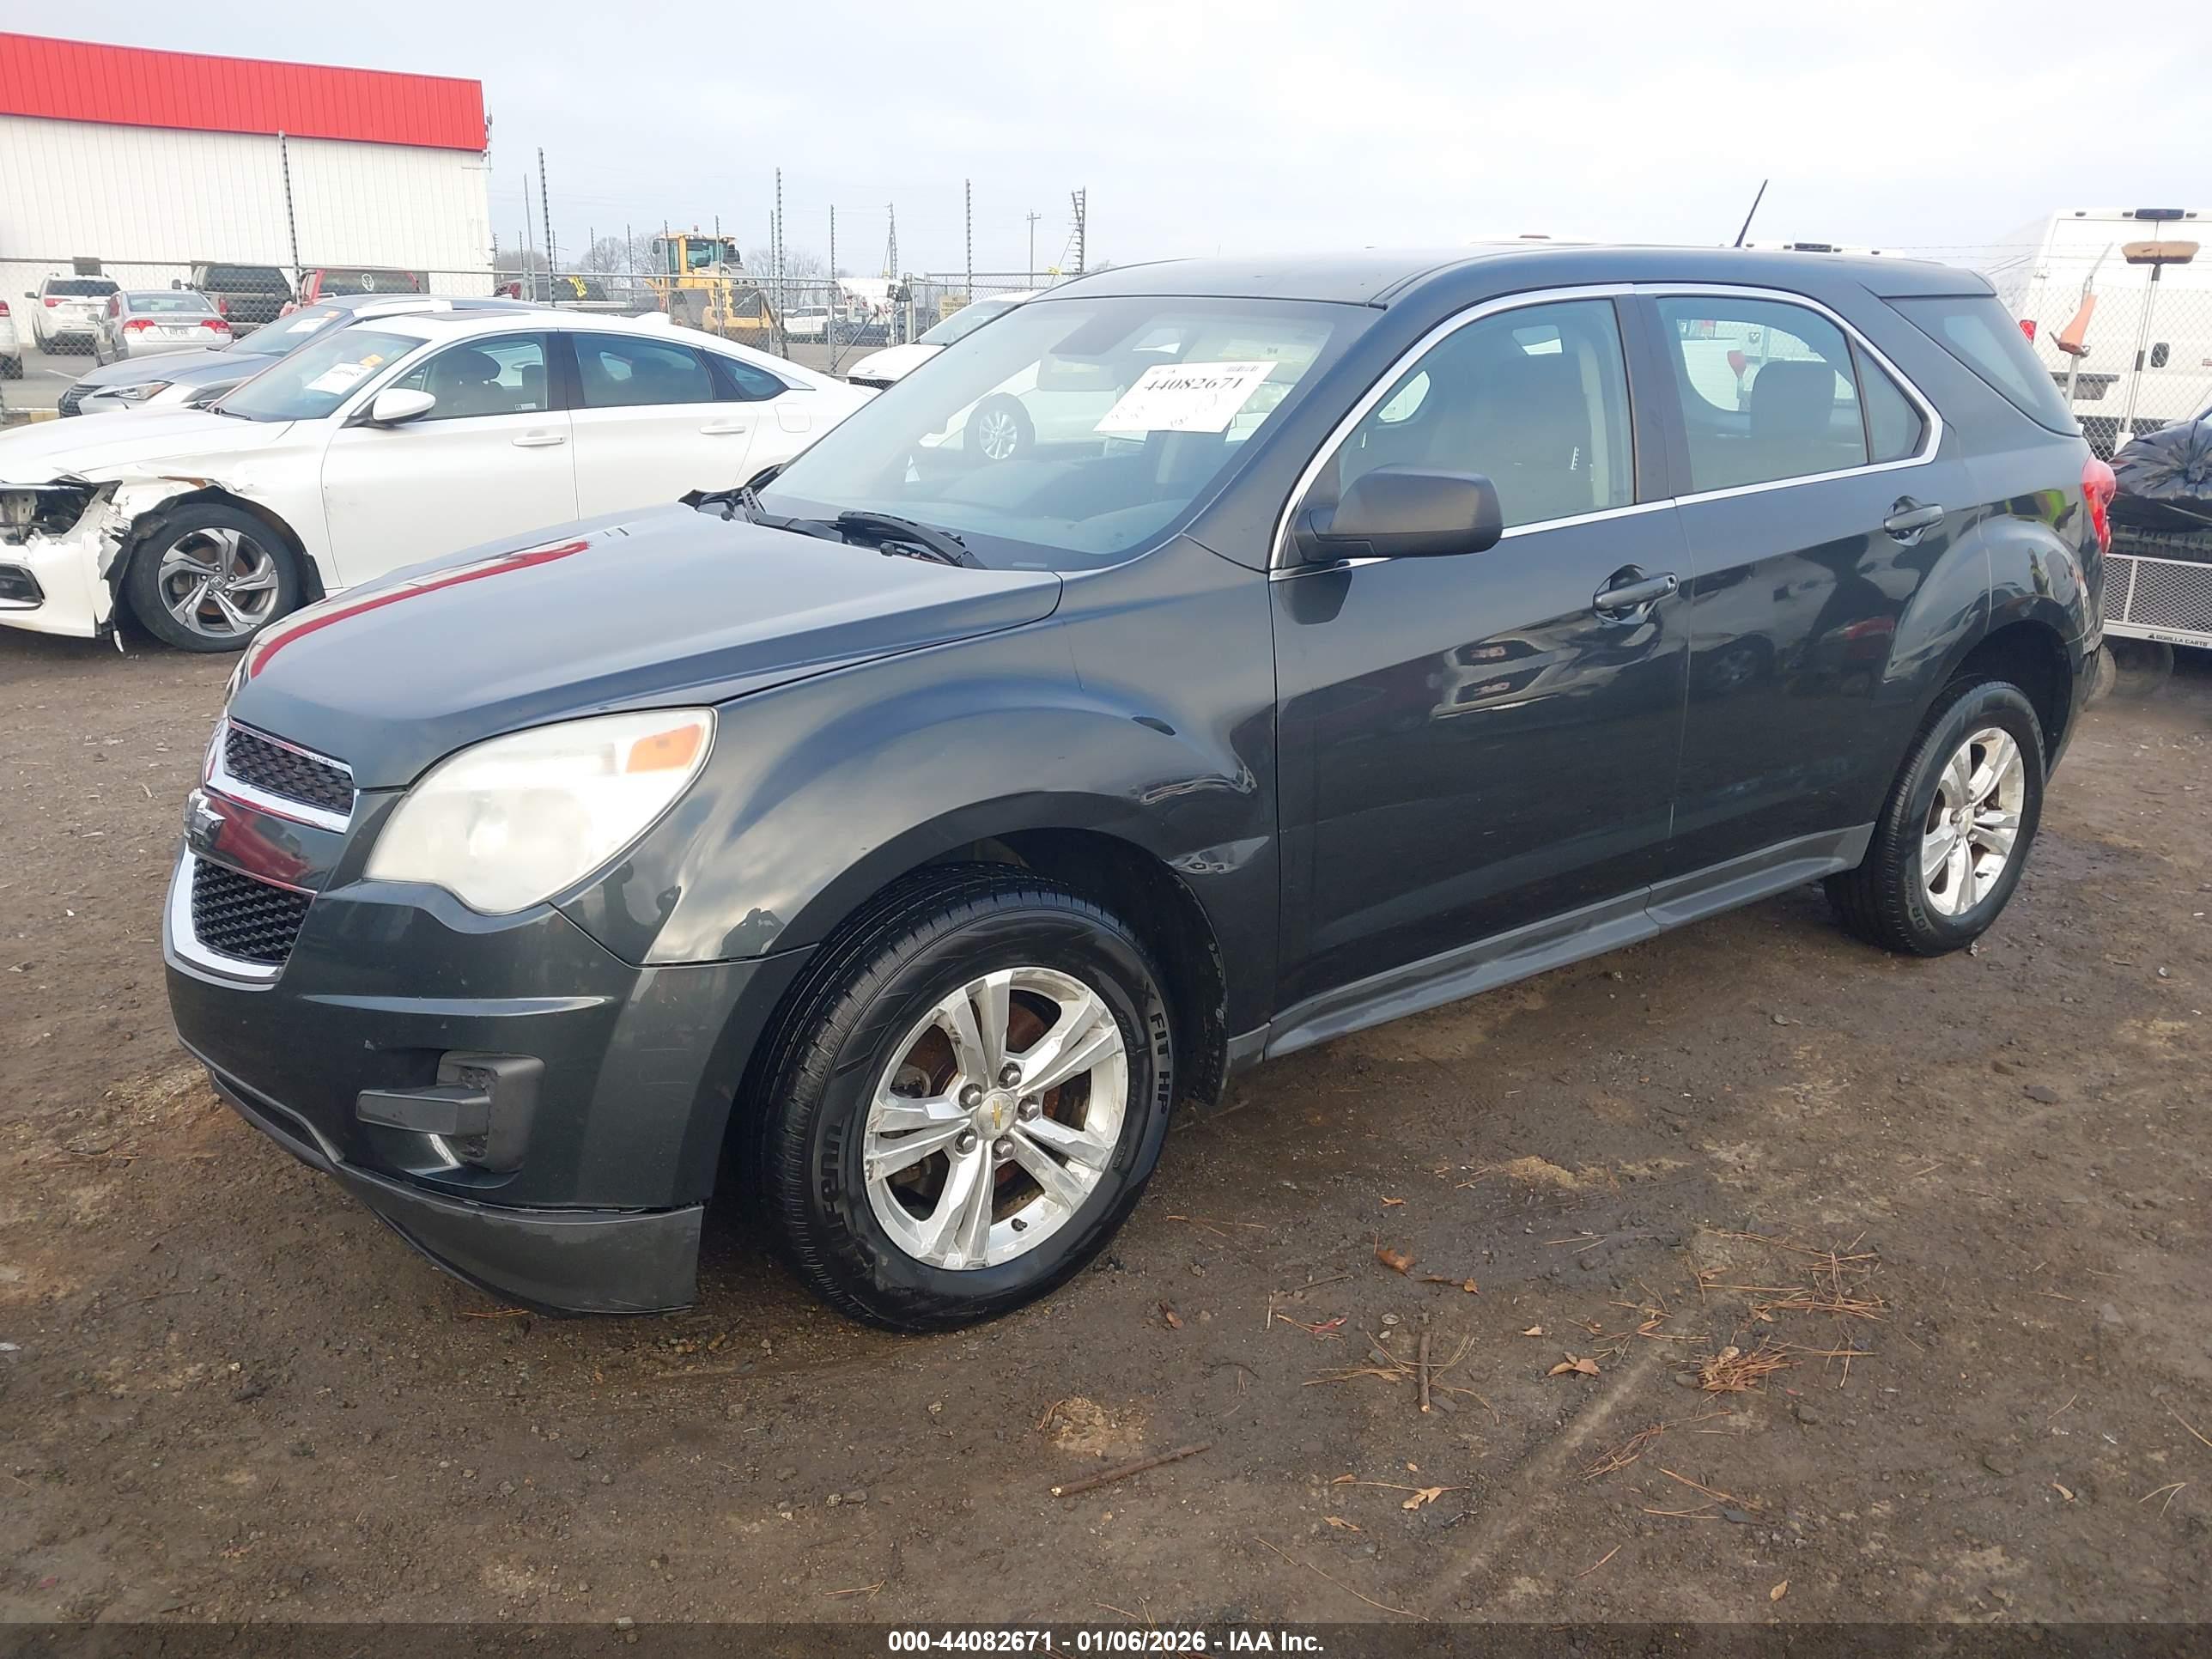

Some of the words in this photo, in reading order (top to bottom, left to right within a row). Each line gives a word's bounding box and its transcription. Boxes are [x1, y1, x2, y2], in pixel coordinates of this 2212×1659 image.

[1144, 377, 1243, 391] 44082671
[1150, 1012, 1170, 1060] FIT
[1158, 1071, 1170, 1115] HP
